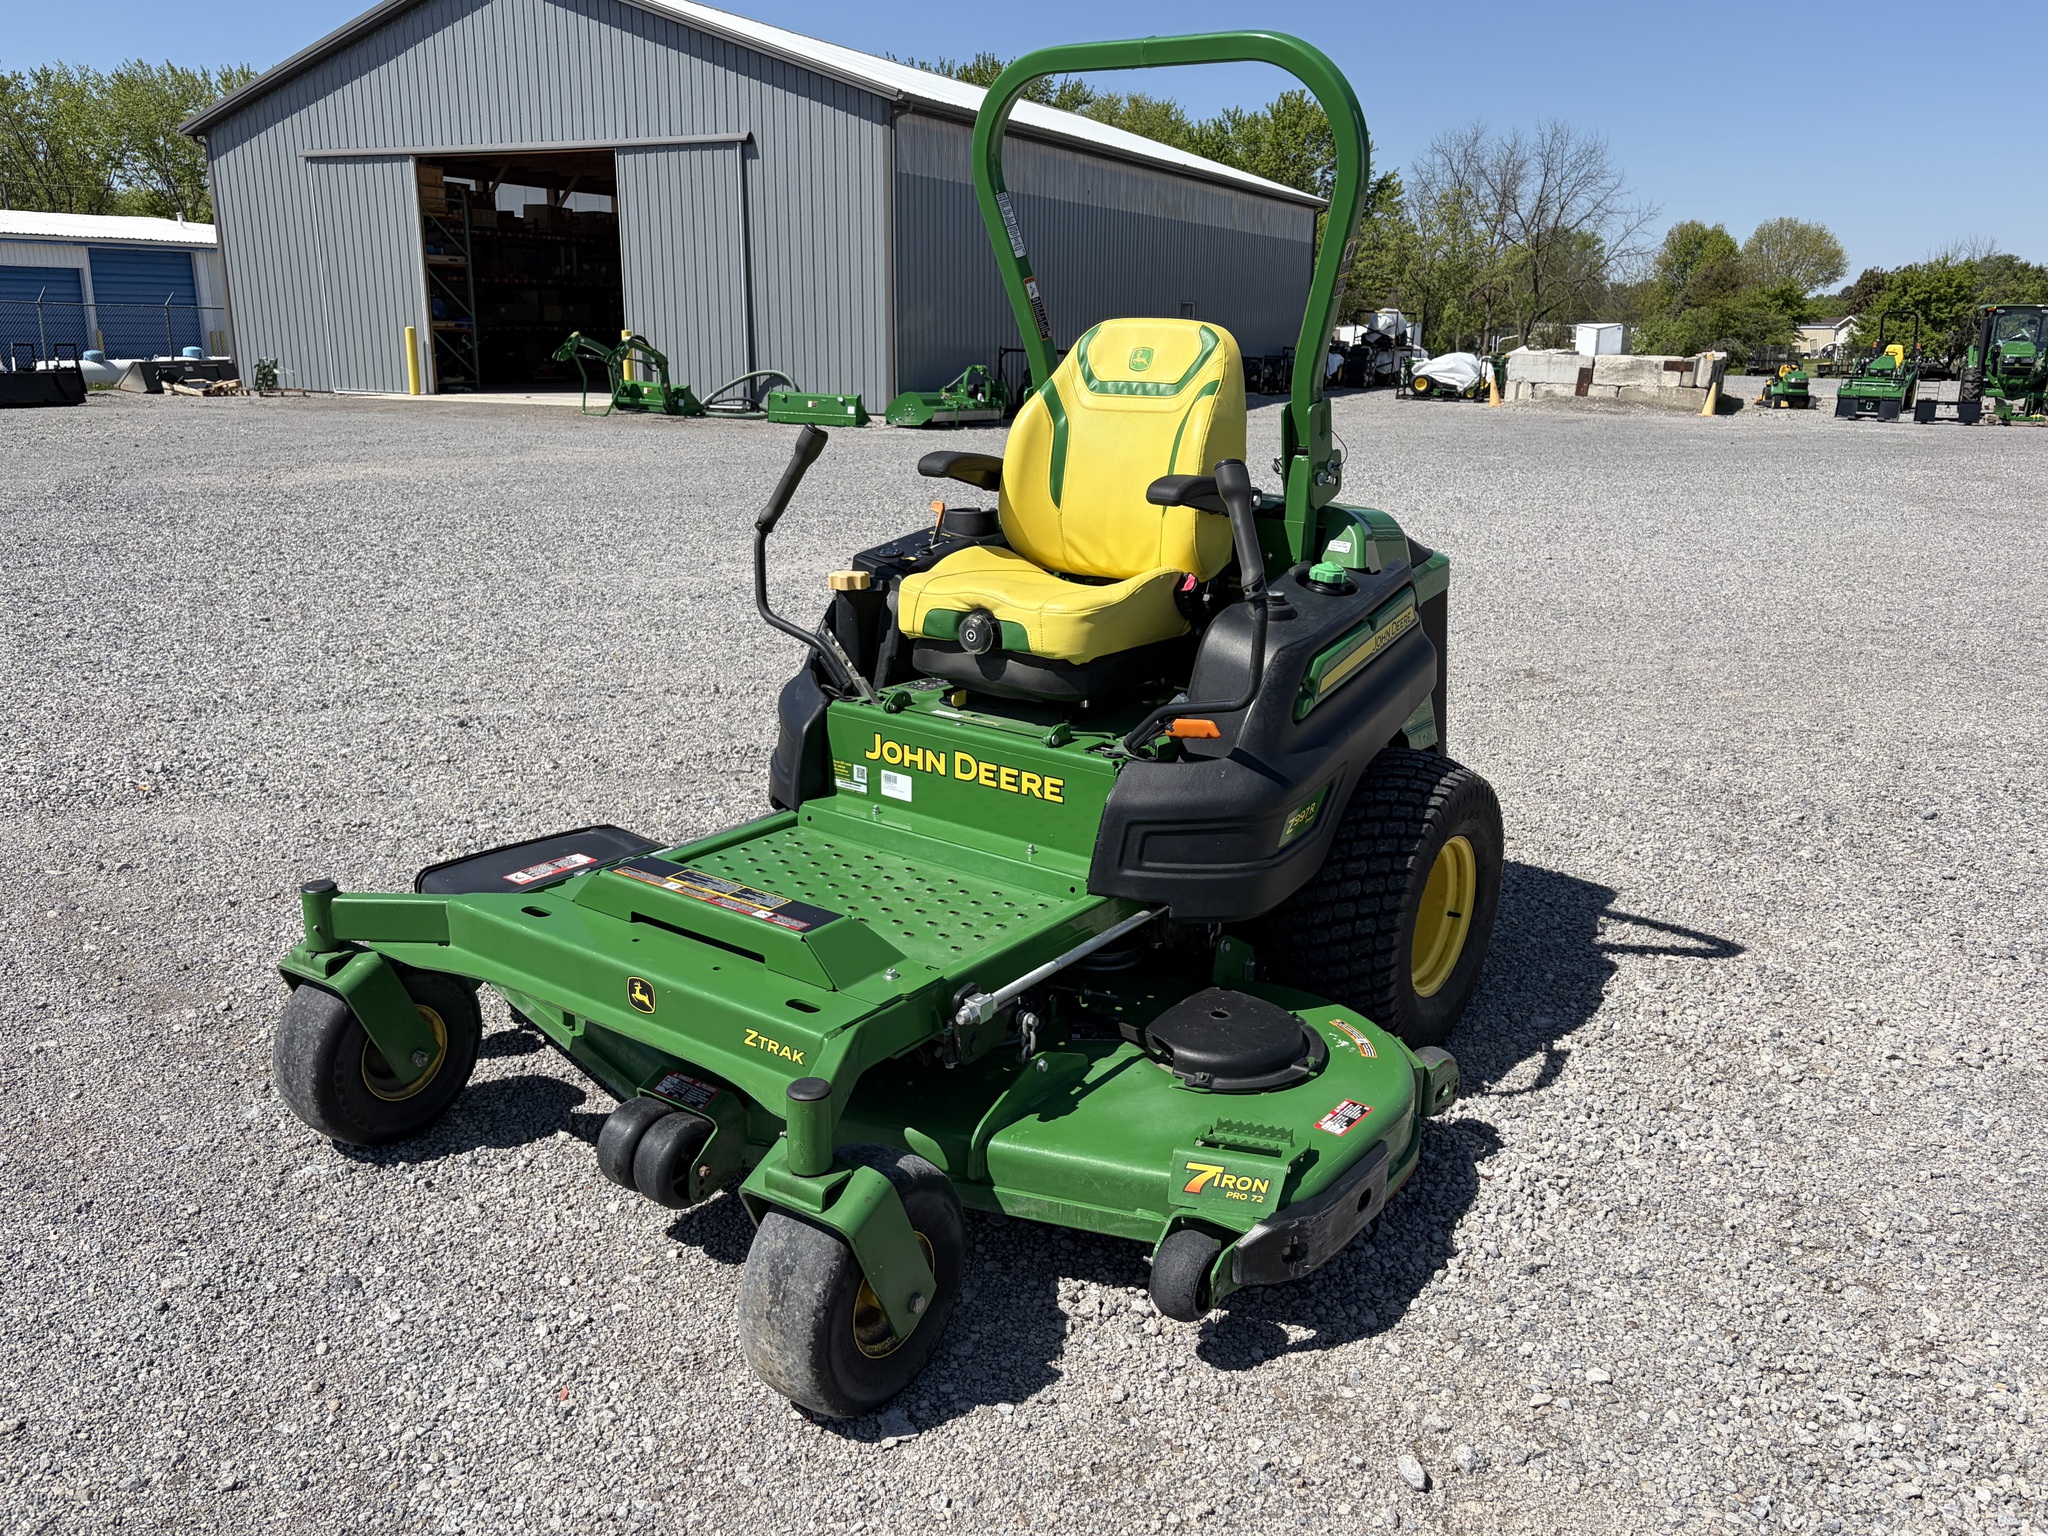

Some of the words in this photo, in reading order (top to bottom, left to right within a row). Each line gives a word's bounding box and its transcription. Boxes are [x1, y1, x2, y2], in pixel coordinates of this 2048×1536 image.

[1372, 627, 1391, 652] JOHN
[1391, 611, 1411, 637] DEERE
[865, 732, 947, 776] JOHN
[954, 750, 1065, 804] DEERE
[744, 1028, 805, 1066] ZTRAK
[1225, 1191, 1248, 1201] PRO
[1251, 1194, 1264, 1203] 72
